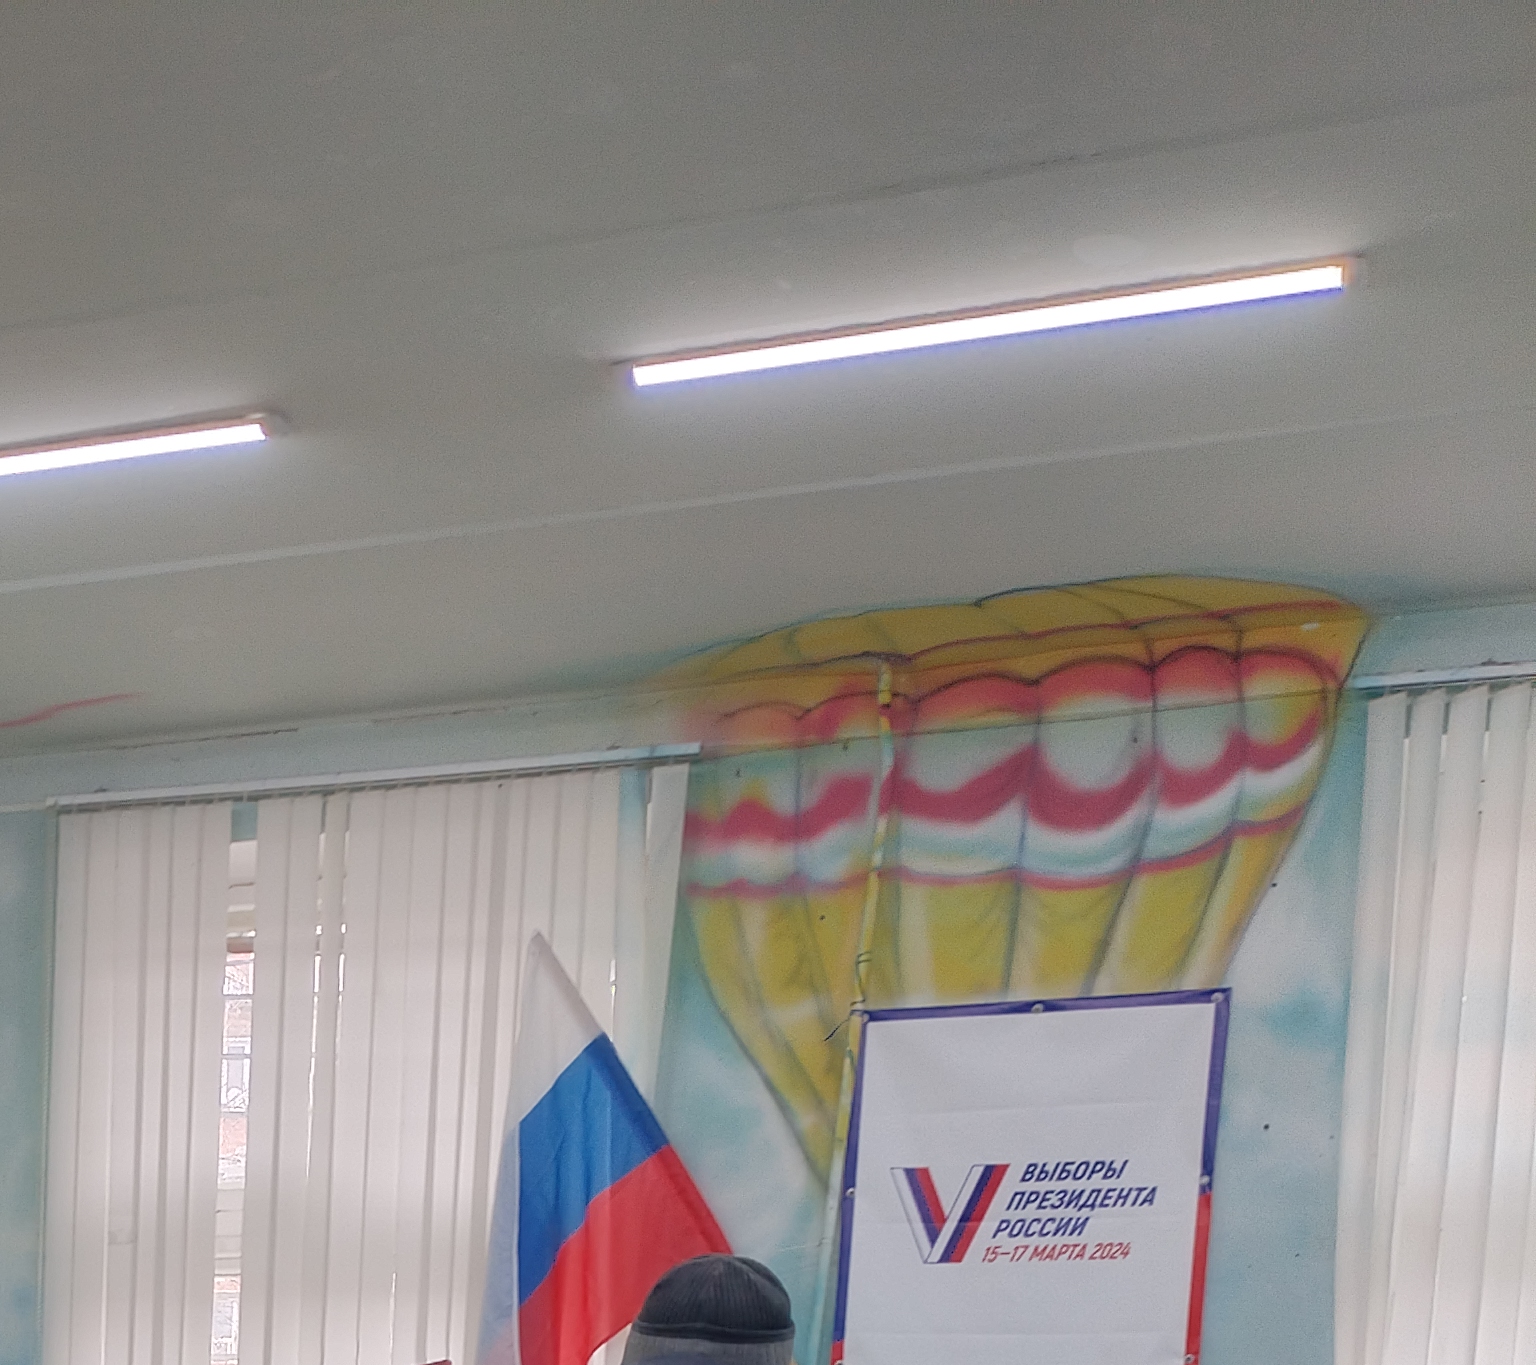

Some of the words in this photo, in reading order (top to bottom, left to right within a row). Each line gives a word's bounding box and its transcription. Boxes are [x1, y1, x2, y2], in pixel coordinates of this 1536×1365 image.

[1020, 1160, 1129, 1183] ВЫБОРЫ
[1005, 1186, 1158, 1212] ПРЕЗИДЕНТА
[991, 1216, 1091, 1239] РОССИИ
[1028, 1244, 1087, 1262] МАРТА
[1088, 1242, 1132, 1260] 2024
